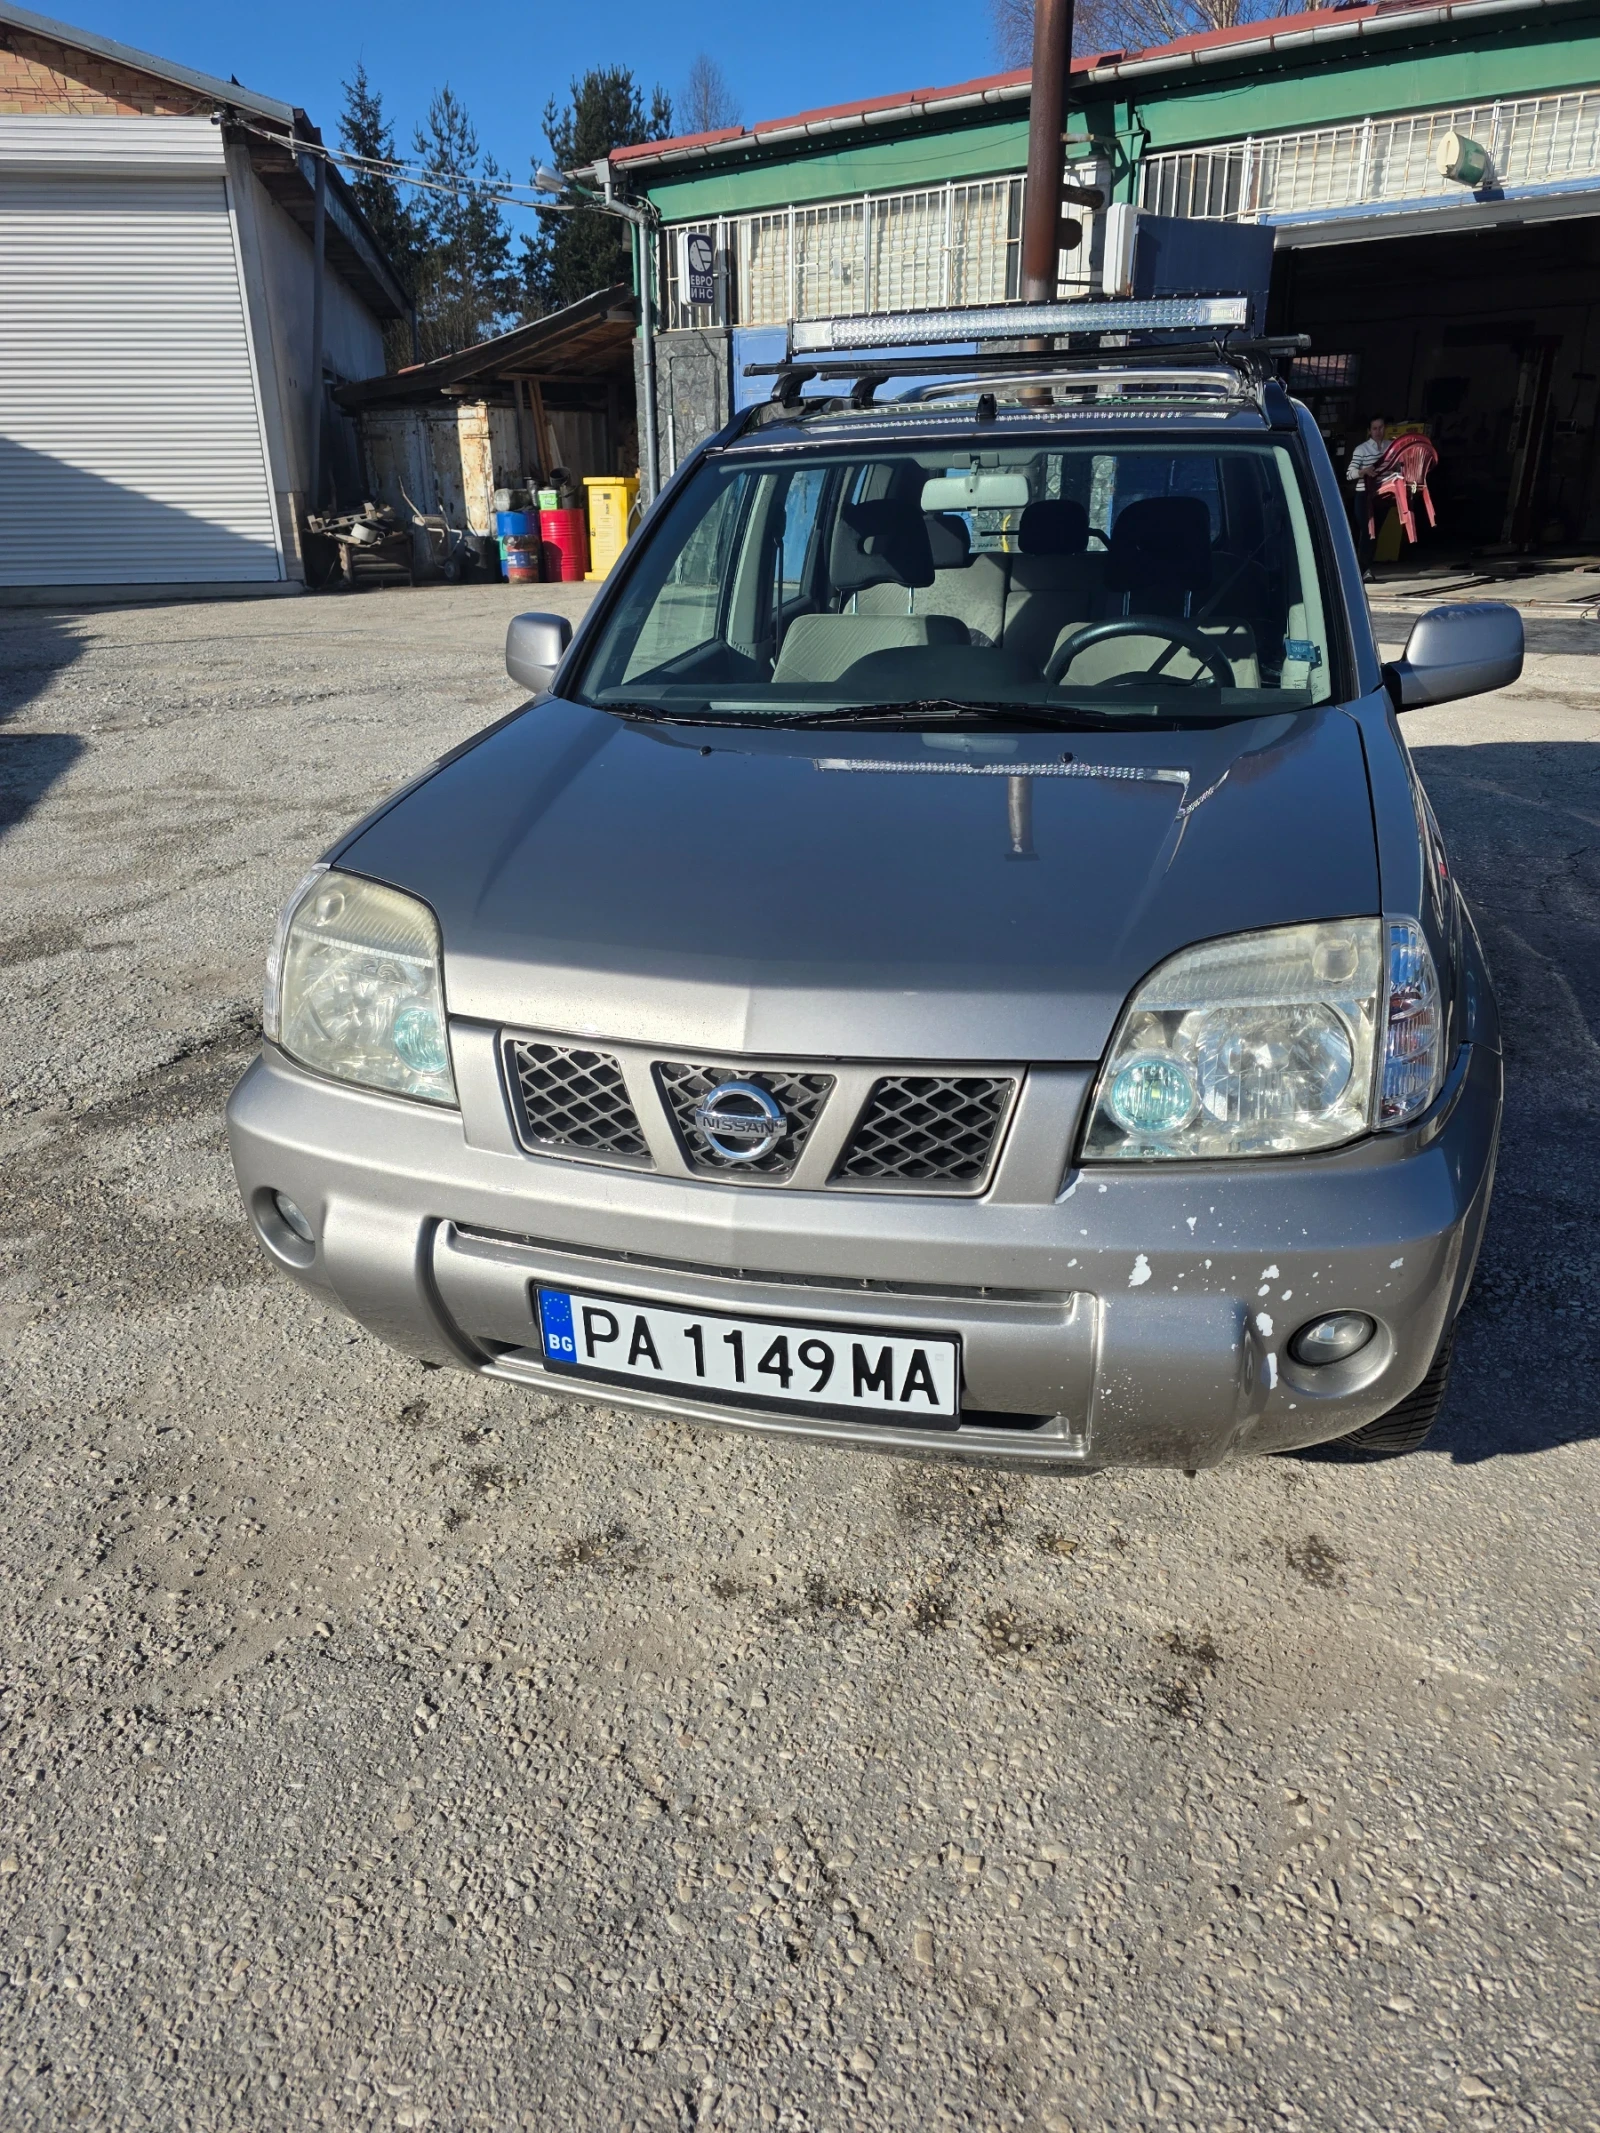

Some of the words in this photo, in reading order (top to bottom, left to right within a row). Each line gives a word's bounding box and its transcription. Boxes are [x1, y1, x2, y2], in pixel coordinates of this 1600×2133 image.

[690, 274, 713, 287] ЕВРО
[690, 287, 714, 299] ИНС
[702, 1116, 775, 1133] NISSAN
[548, 1333, 573, 1352] BG
[582, 1305, 663, 1371] PA
[683, 1323, 836, 1393] 1149
[852, 1343, 940, 1405] MA
